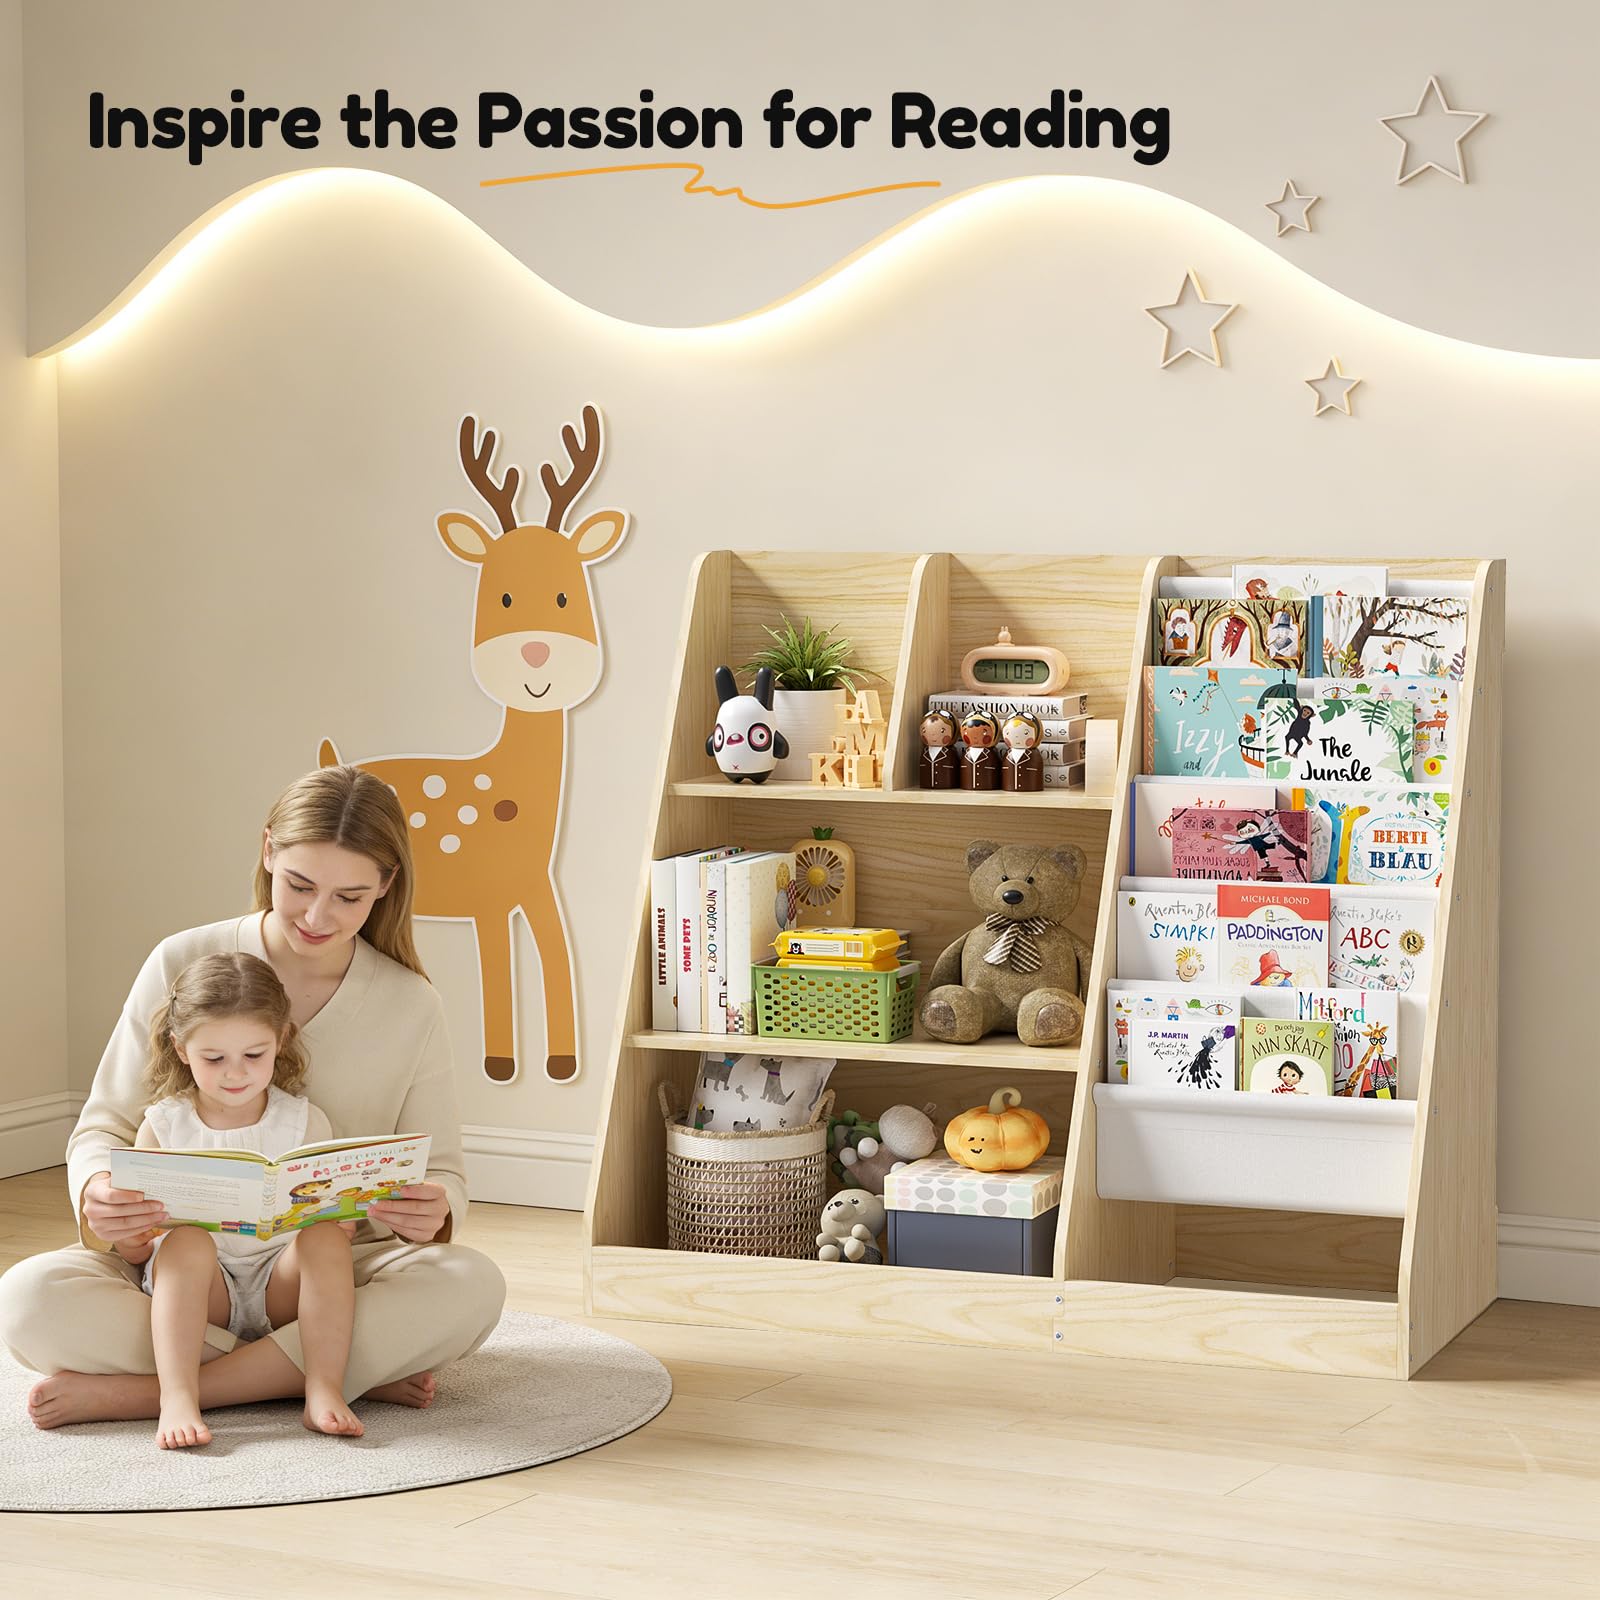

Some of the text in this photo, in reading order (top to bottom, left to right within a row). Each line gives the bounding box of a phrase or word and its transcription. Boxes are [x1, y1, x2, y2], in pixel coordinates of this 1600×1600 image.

[931, 701, 1060, 715] THE FASHION BOOK
[1173, 720, 1235, 777] Izzy
[1319, 736, 1353, 759] The
[1183, 757, 1202, 771] and
[1300, 759, 1372, 782] Jungle
[1372, 829, 1429, 845] BERTI
[1368, 851, 1433, 871] BLAU
[1240, 895, 1310, 905] MICHAEL BOND
[1191, 902, 1217, 922] Bla
[1149, 922, 1215, 941] SIMPKI
[1340, 926, 1391, 950] ABC
[657, 907, 667, 986] LITTLE ANIMALS
[682, 918, 692, 973] SOME PETS
[1299, 991, 1367, 1023] Mitford
[1161, 1032, 1189, 1040] MARTIN
[1251, 1033, 1329, 1060] MIN SKATT
